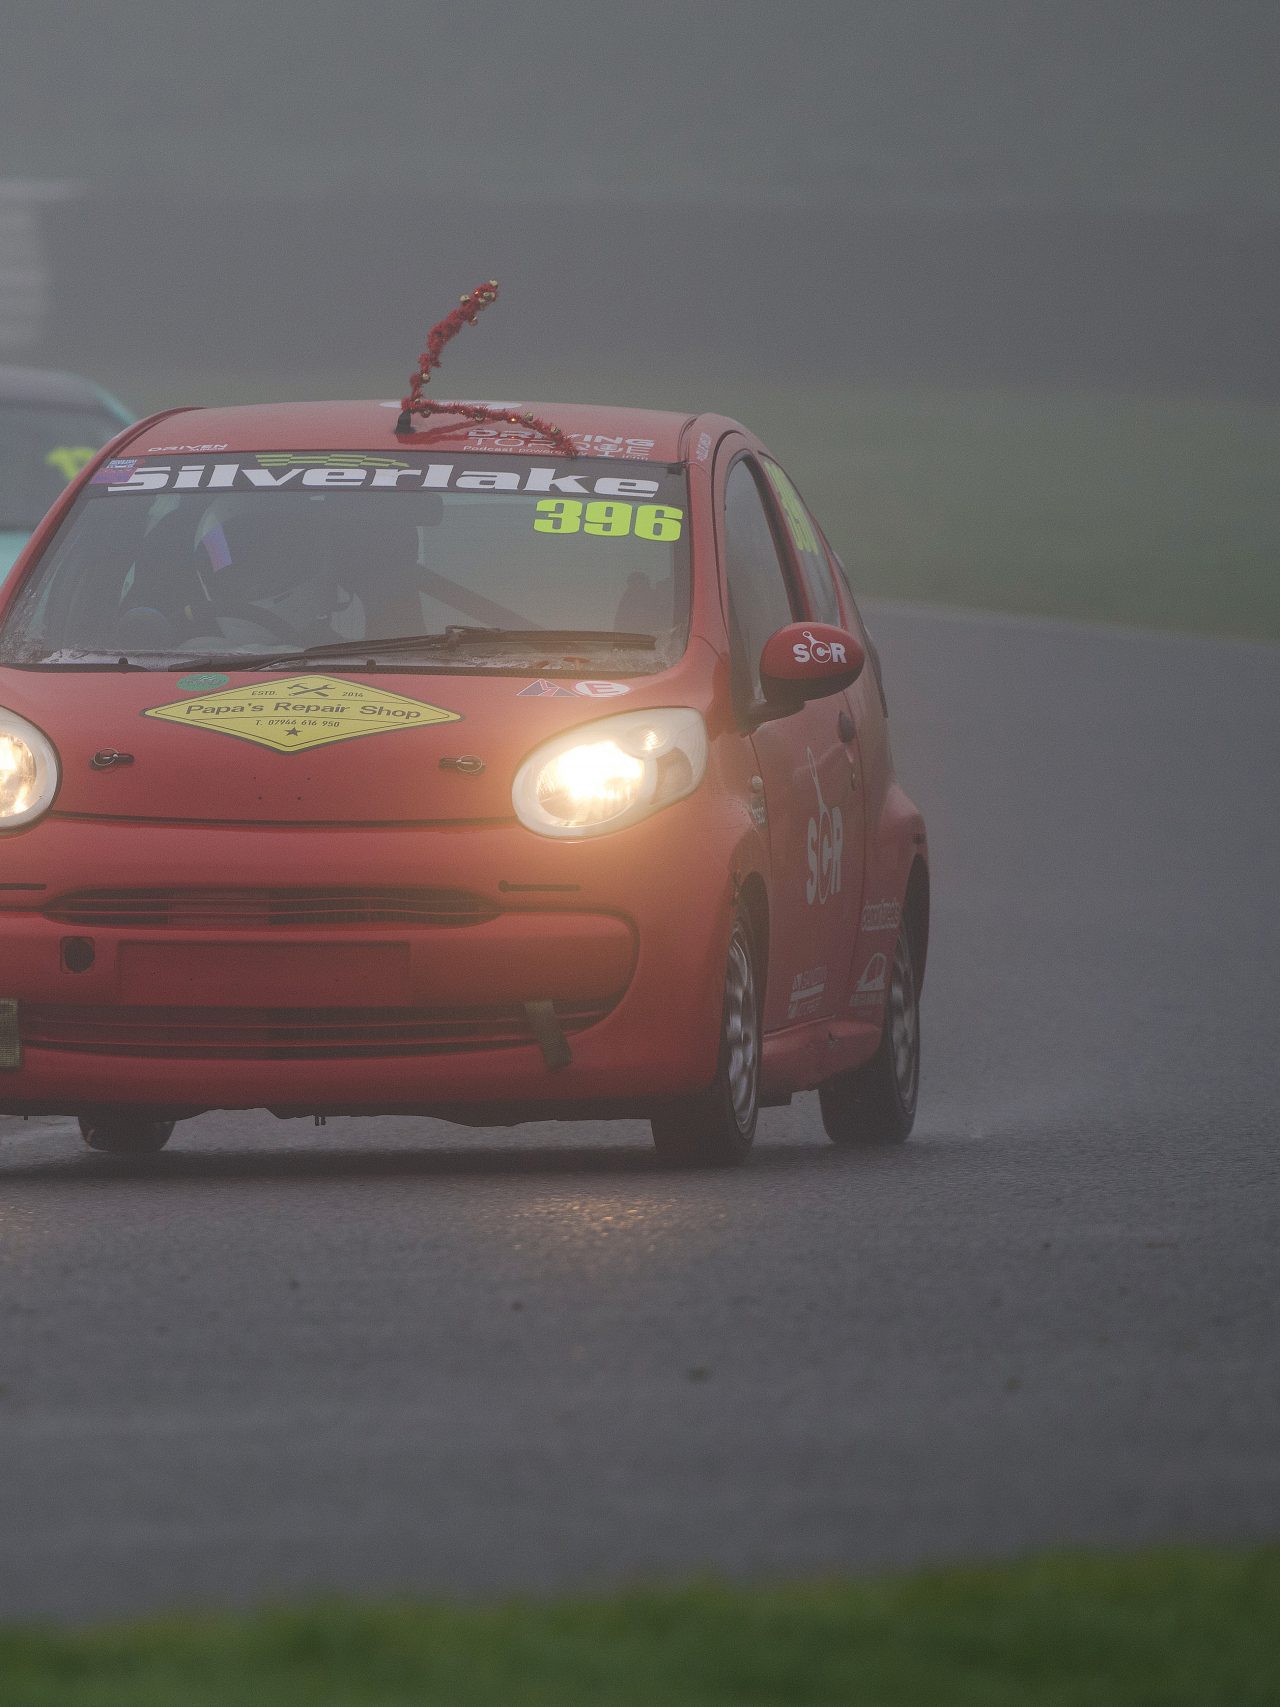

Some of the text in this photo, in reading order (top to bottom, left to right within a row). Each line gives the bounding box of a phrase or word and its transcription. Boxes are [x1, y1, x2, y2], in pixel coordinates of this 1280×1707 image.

[107, 463, 659, 498] Silverlake
[533, 499, 684, 542] 396
[792, 643, 847, 664] SCR
[185, 702, 421, 719] Papa's Repair Shop
[806, 806, 844, 905] SCR
